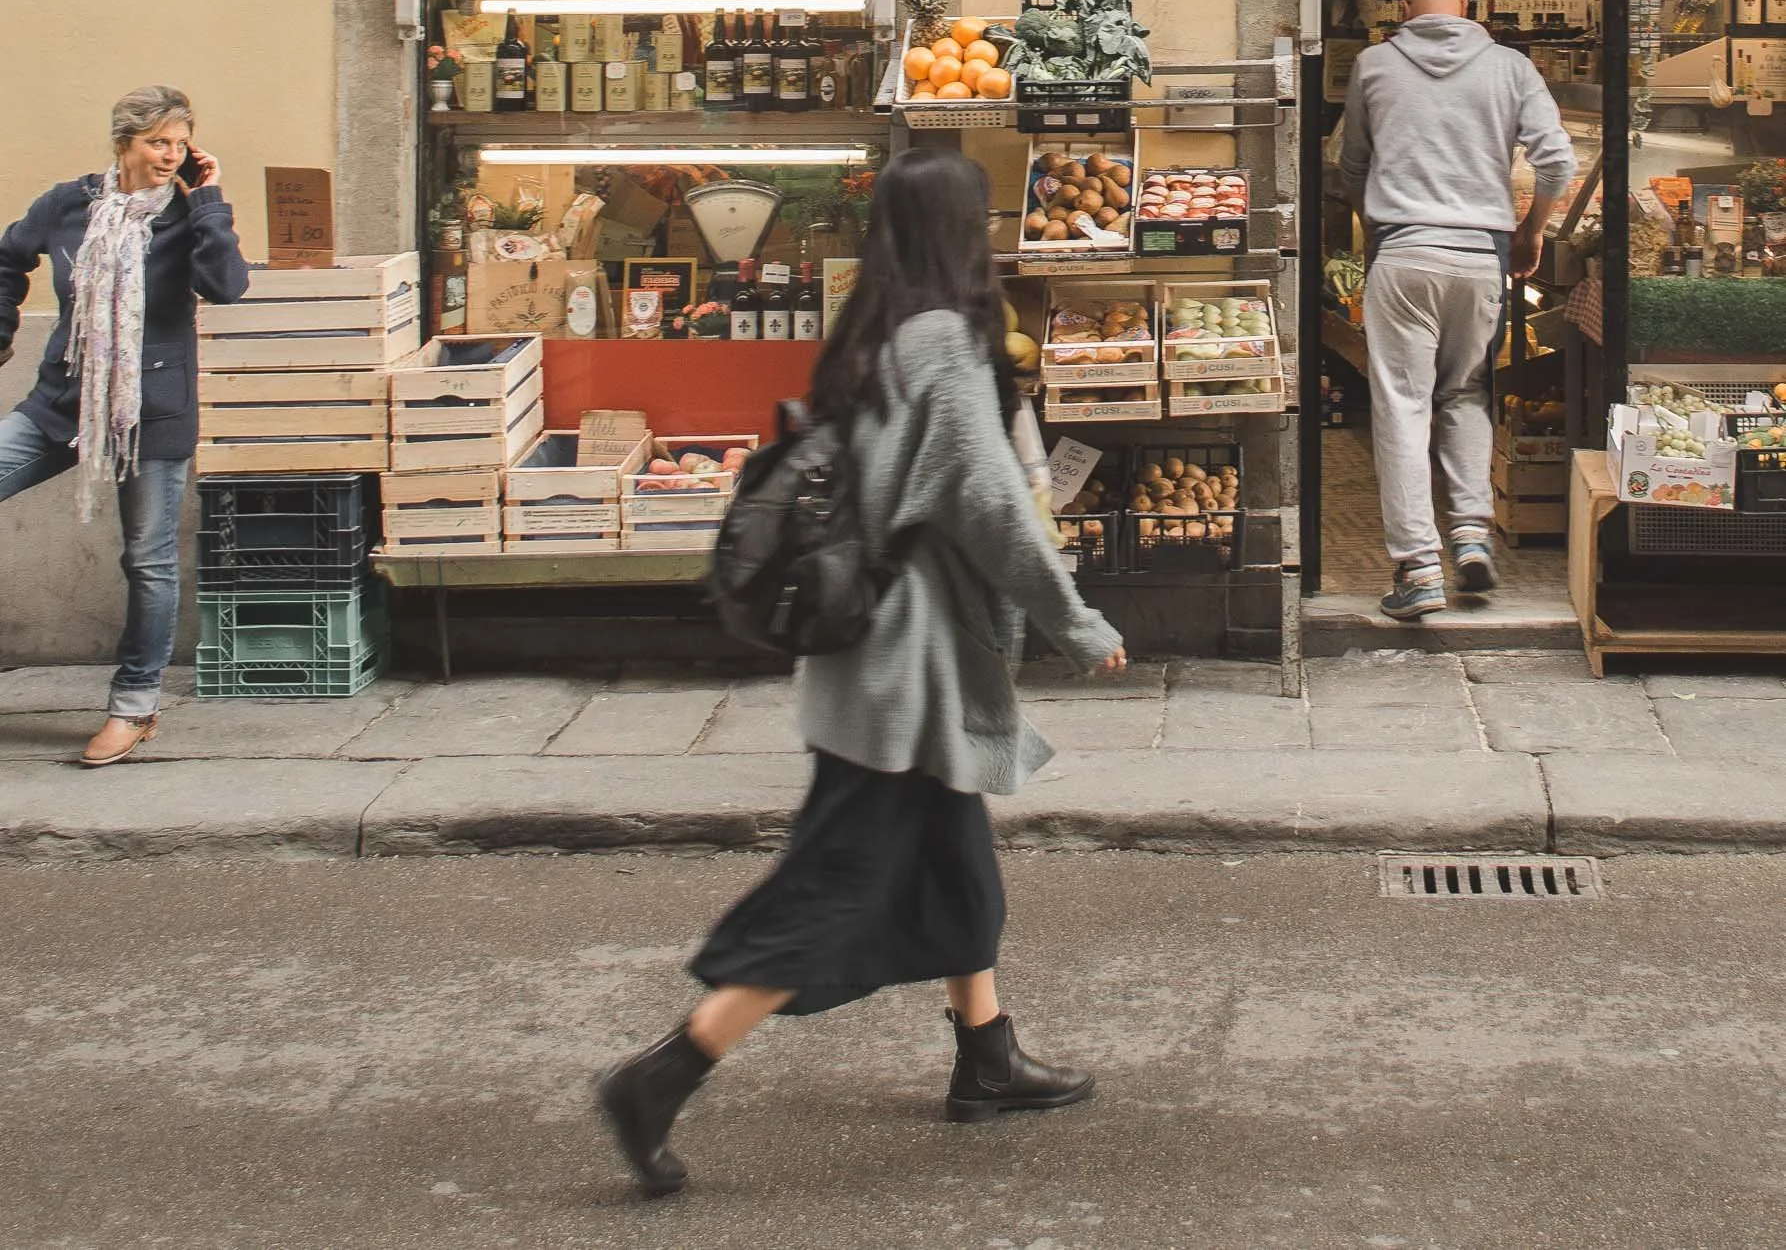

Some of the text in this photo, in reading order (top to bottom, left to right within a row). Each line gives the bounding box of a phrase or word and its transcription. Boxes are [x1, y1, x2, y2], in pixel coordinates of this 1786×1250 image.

[1087, 369, 1114, 377] CUSI
[1208, 364, 1236, 373] CUSI
[1214, 400, 1241, 409] CUSI
[1094, 406, 1120, 415] CUSI
